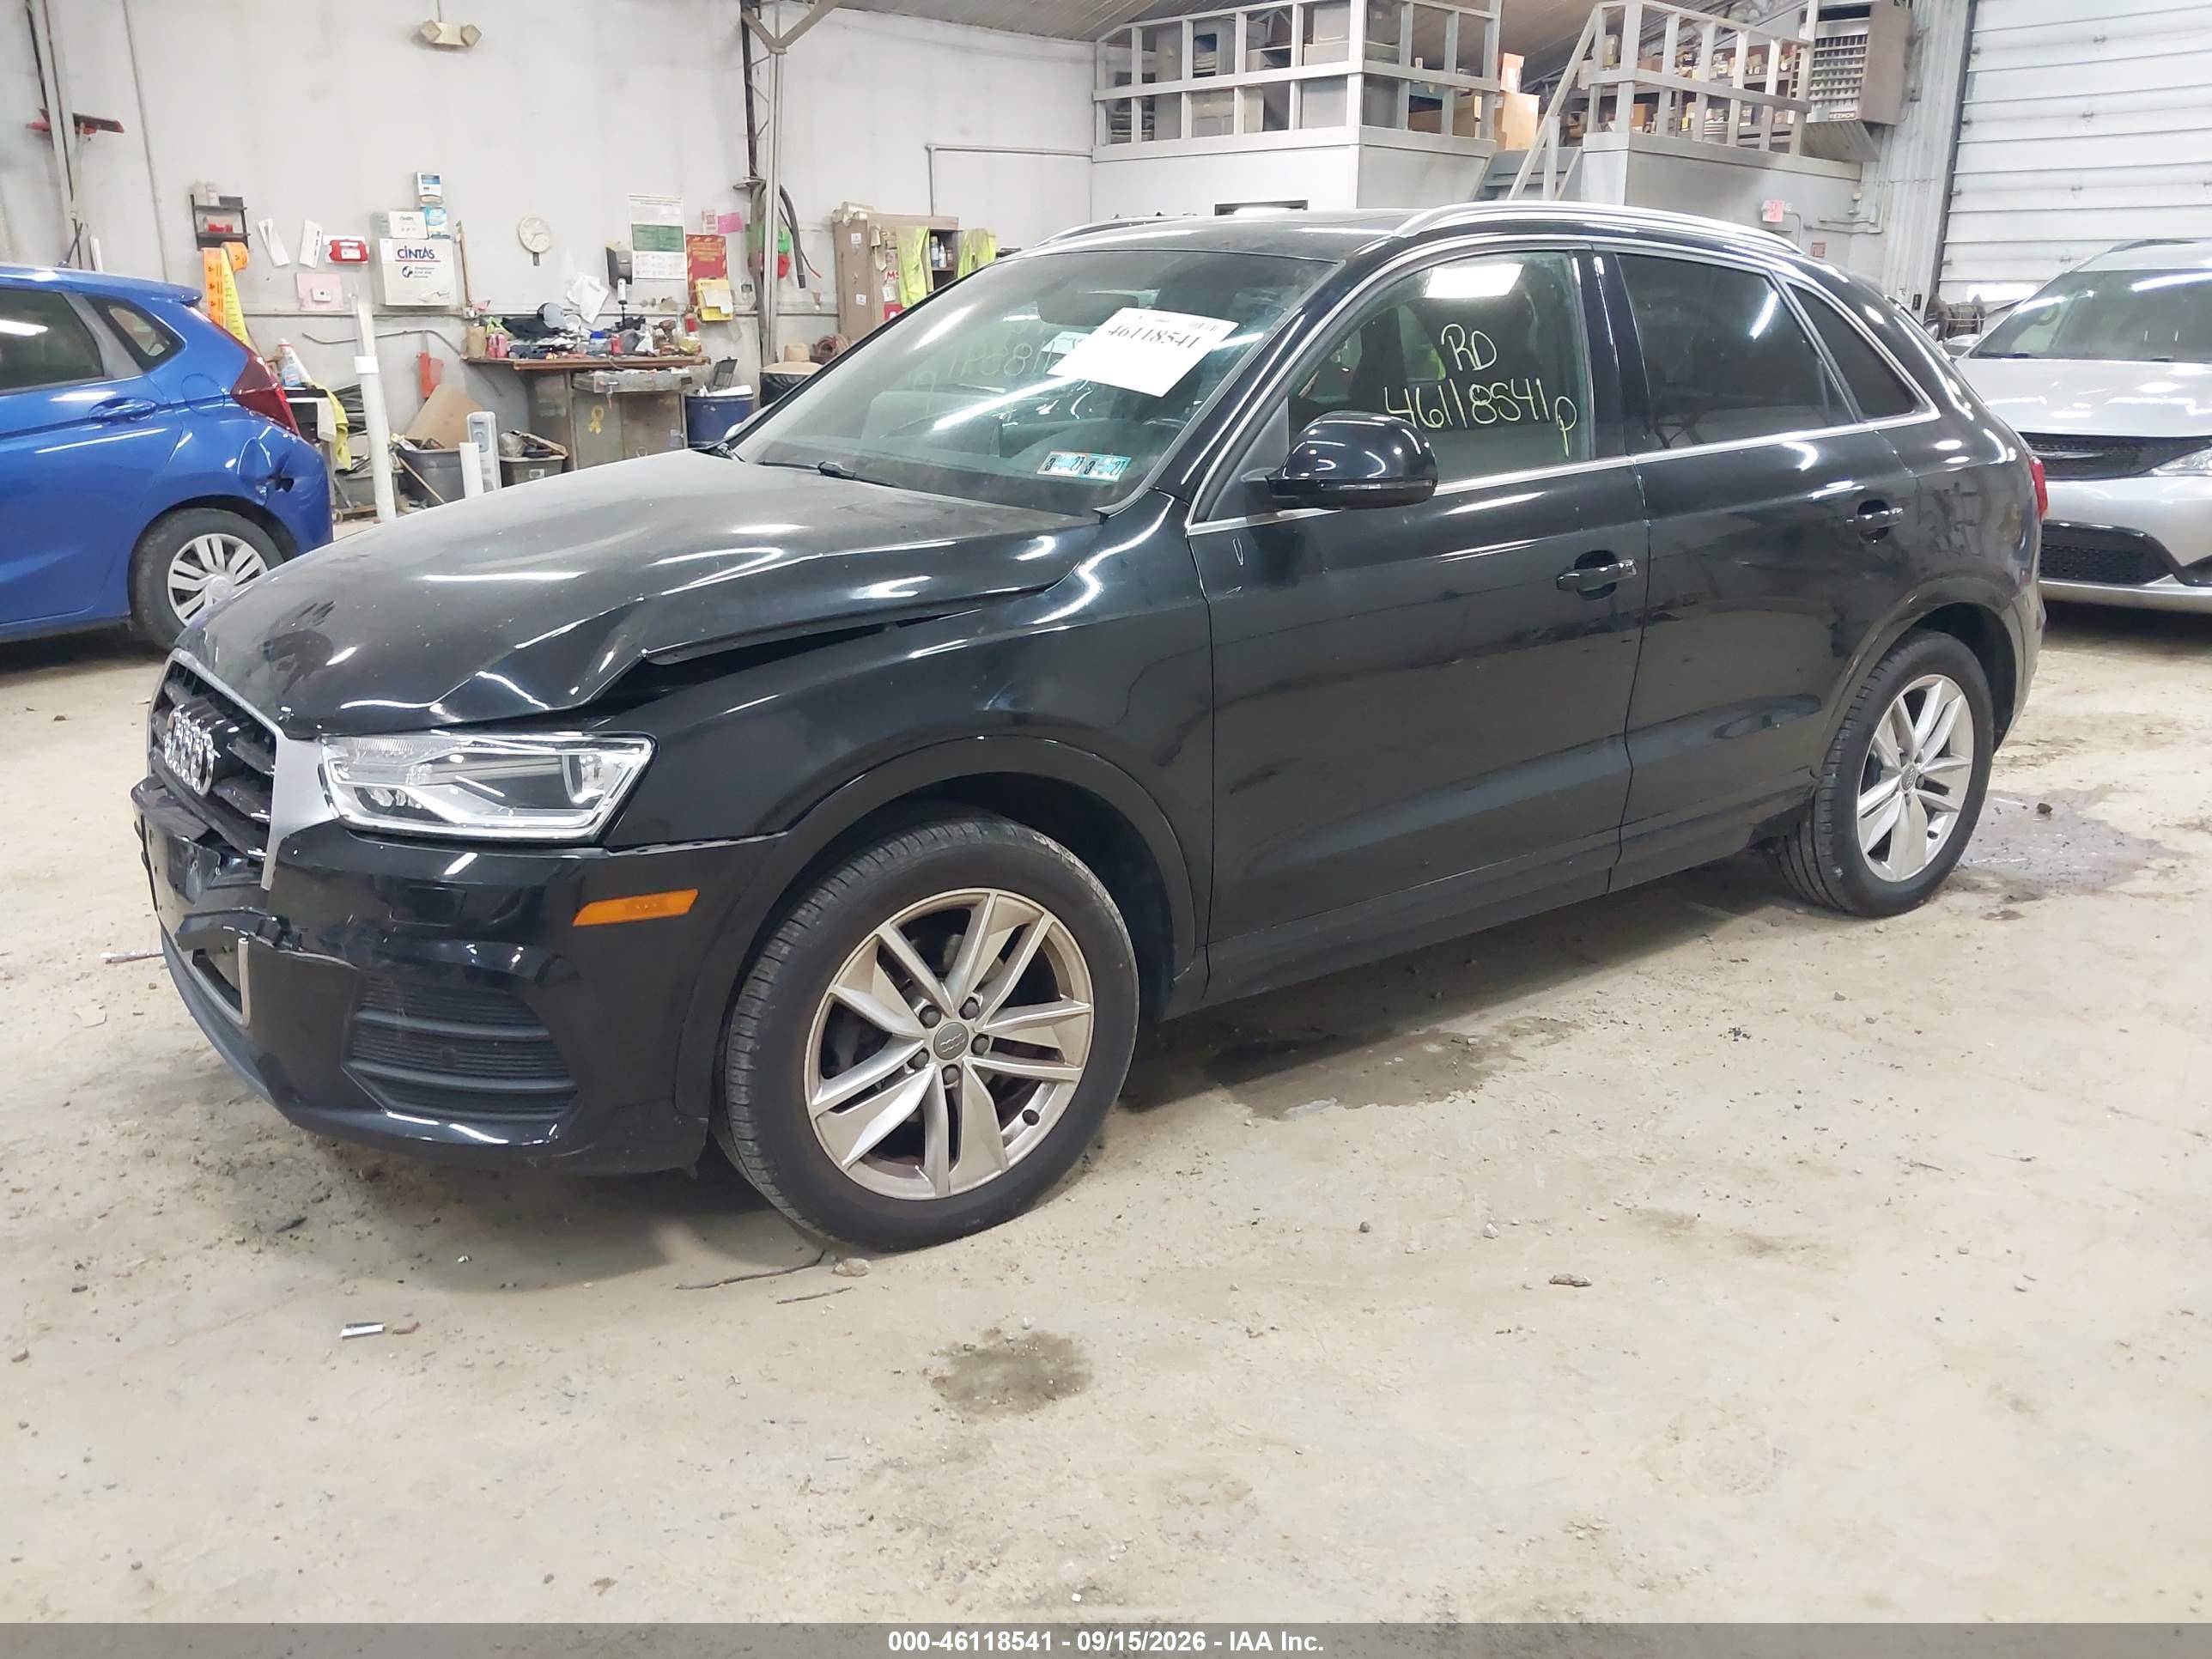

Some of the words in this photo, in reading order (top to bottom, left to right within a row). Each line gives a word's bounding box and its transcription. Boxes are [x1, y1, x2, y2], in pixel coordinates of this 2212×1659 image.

[1108, 324, 1201, 349] 46118541
[1440, 323, 1498, 372] RD
[1044, 457, 1056, 471] 3
[1084, 460, 1097, 475] 3
